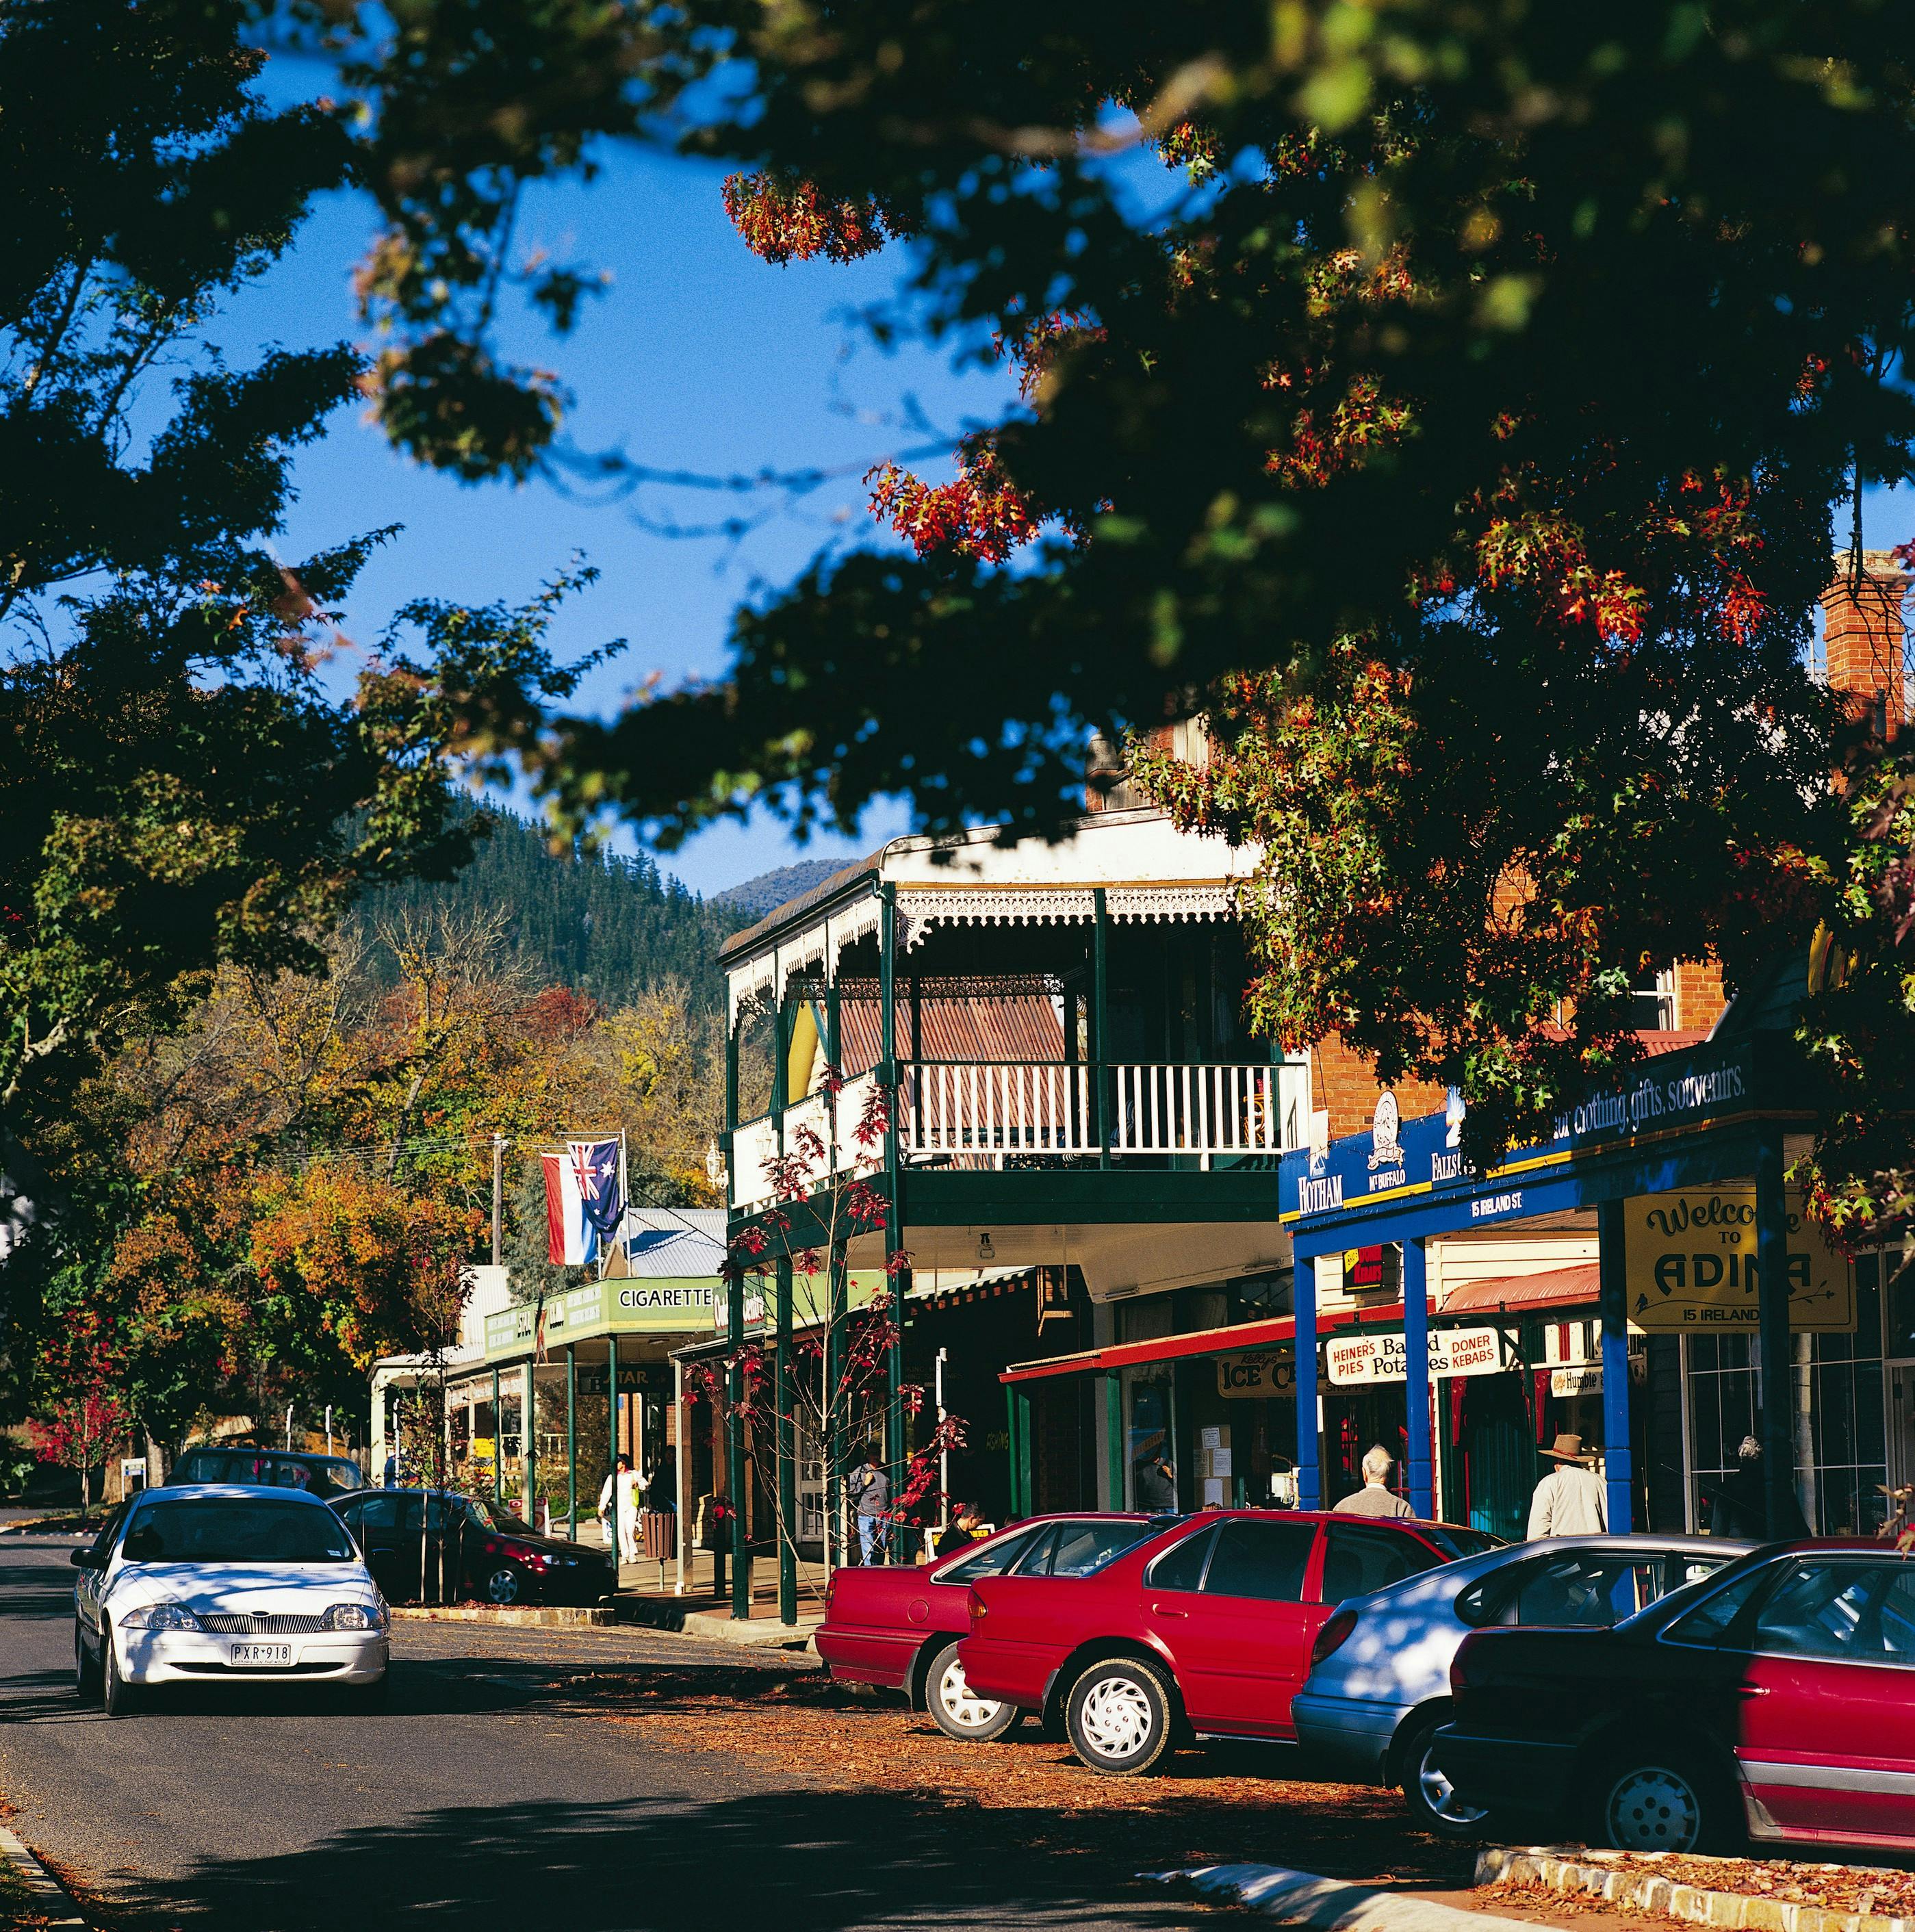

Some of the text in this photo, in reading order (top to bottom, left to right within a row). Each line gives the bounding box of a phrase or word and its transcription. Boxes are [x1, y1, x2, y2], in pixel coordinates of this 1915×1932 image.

[1667, 1061, 1746, 1112] souvenirs.
[1430, 1152, 1456, 1182] FALLS
[1378, 1169, 1406, 1190] BUFFALO
[1298, 1175, 1343, 1215] HOTHAM
[1471, 1201, 1480, 1218] 15
[1480, 1194, 1511, 1216] IRELAND
[1647, 1196, 1801, 1236] Welcoe
[1719, 1231, 1741, 1244] TO
[619, 1289, 712, 1308] CIGARETTE
[1683, 1309, 1760, 1322] 15 IRELAND
[1382, 1335, 1441, 1356] Bad
[1452, 1335, 1490, 1354] DONER
[1338, 1361, 1364, 1376] PIES
[1373, 1356, 1449, 1375] Potaes
[1452, 1348, 1494, 1368] KEBABS
[1222, 1362, 1261, 1389] ICE
